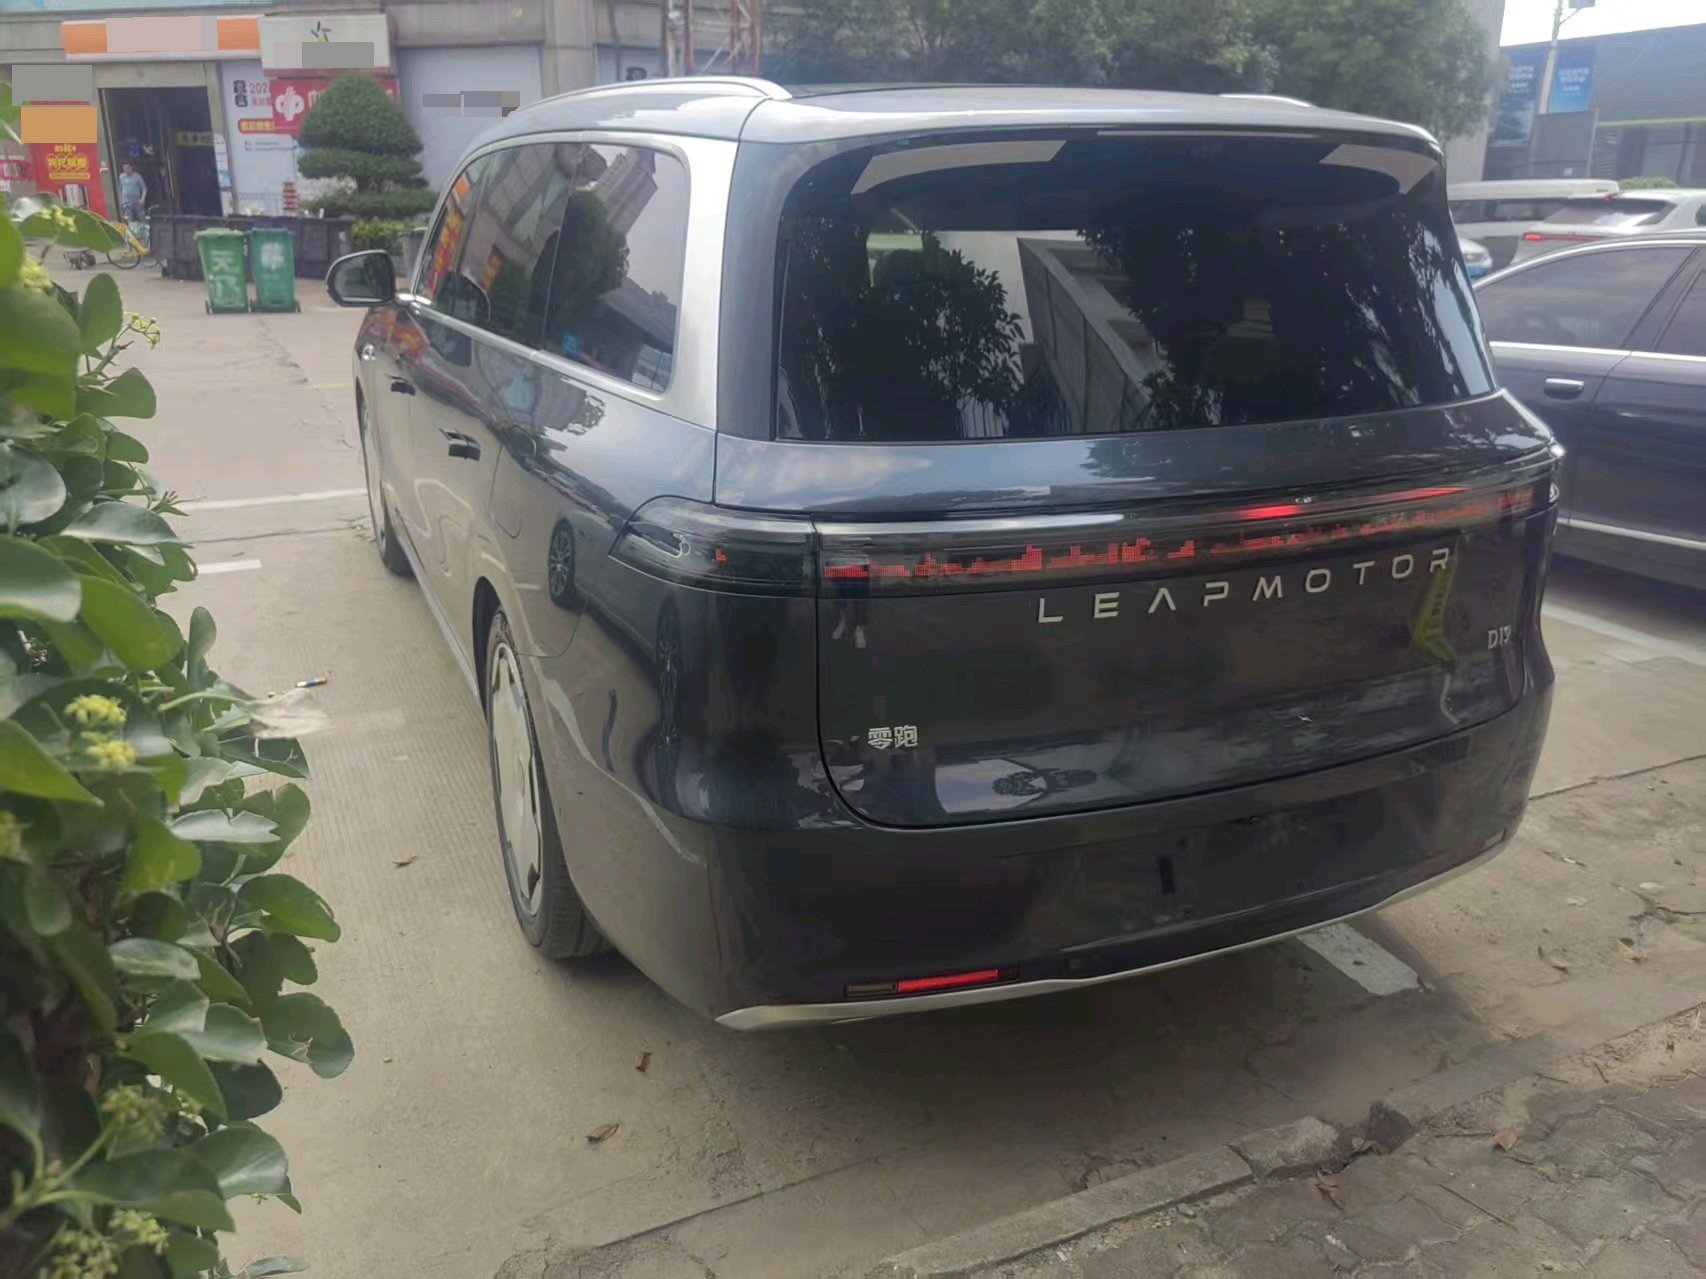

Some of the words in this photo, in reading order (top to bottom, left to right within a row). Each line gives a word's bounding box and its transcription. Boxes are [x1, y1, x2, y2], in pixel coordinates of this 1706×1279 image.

[1038, 547, 1450, 624] LEAPMOTOR
[1488, 624, 1512, 649] D19
[867, 725, 918, 750] 零跑
